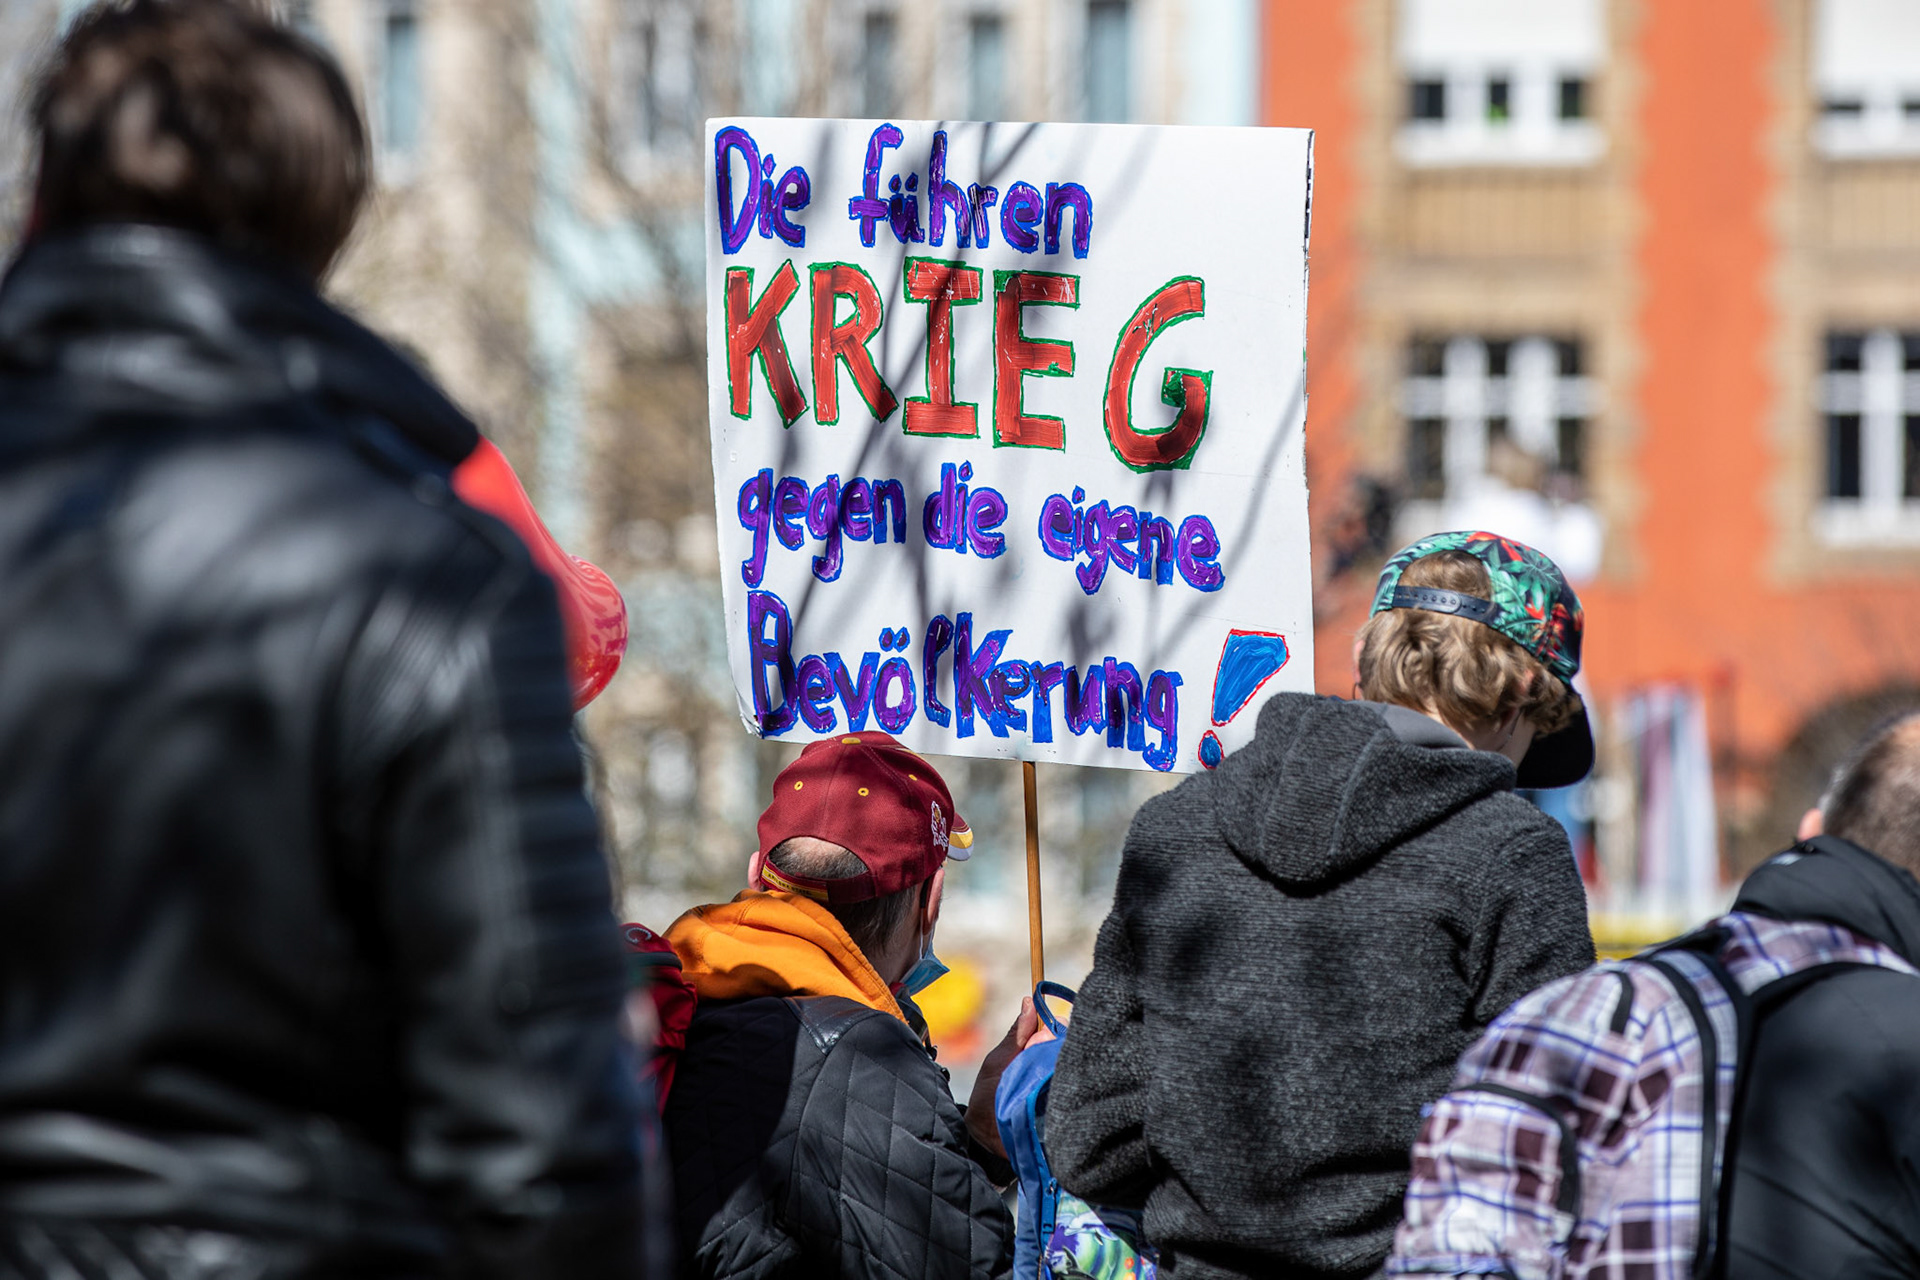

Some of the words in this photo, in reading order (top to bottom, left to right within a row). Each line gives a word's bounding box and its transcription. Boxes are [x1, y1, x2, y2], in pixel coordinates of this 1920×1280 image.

[715, 126, 811, 254] Die
[848, 123, 1092, 259] führen
[725, 257, 1213, 472] KRIEG
[738, 468, 906, 588] gegen
[924, 460, 1008, 559] die
[1039, 486, 1226, 595] eigene
